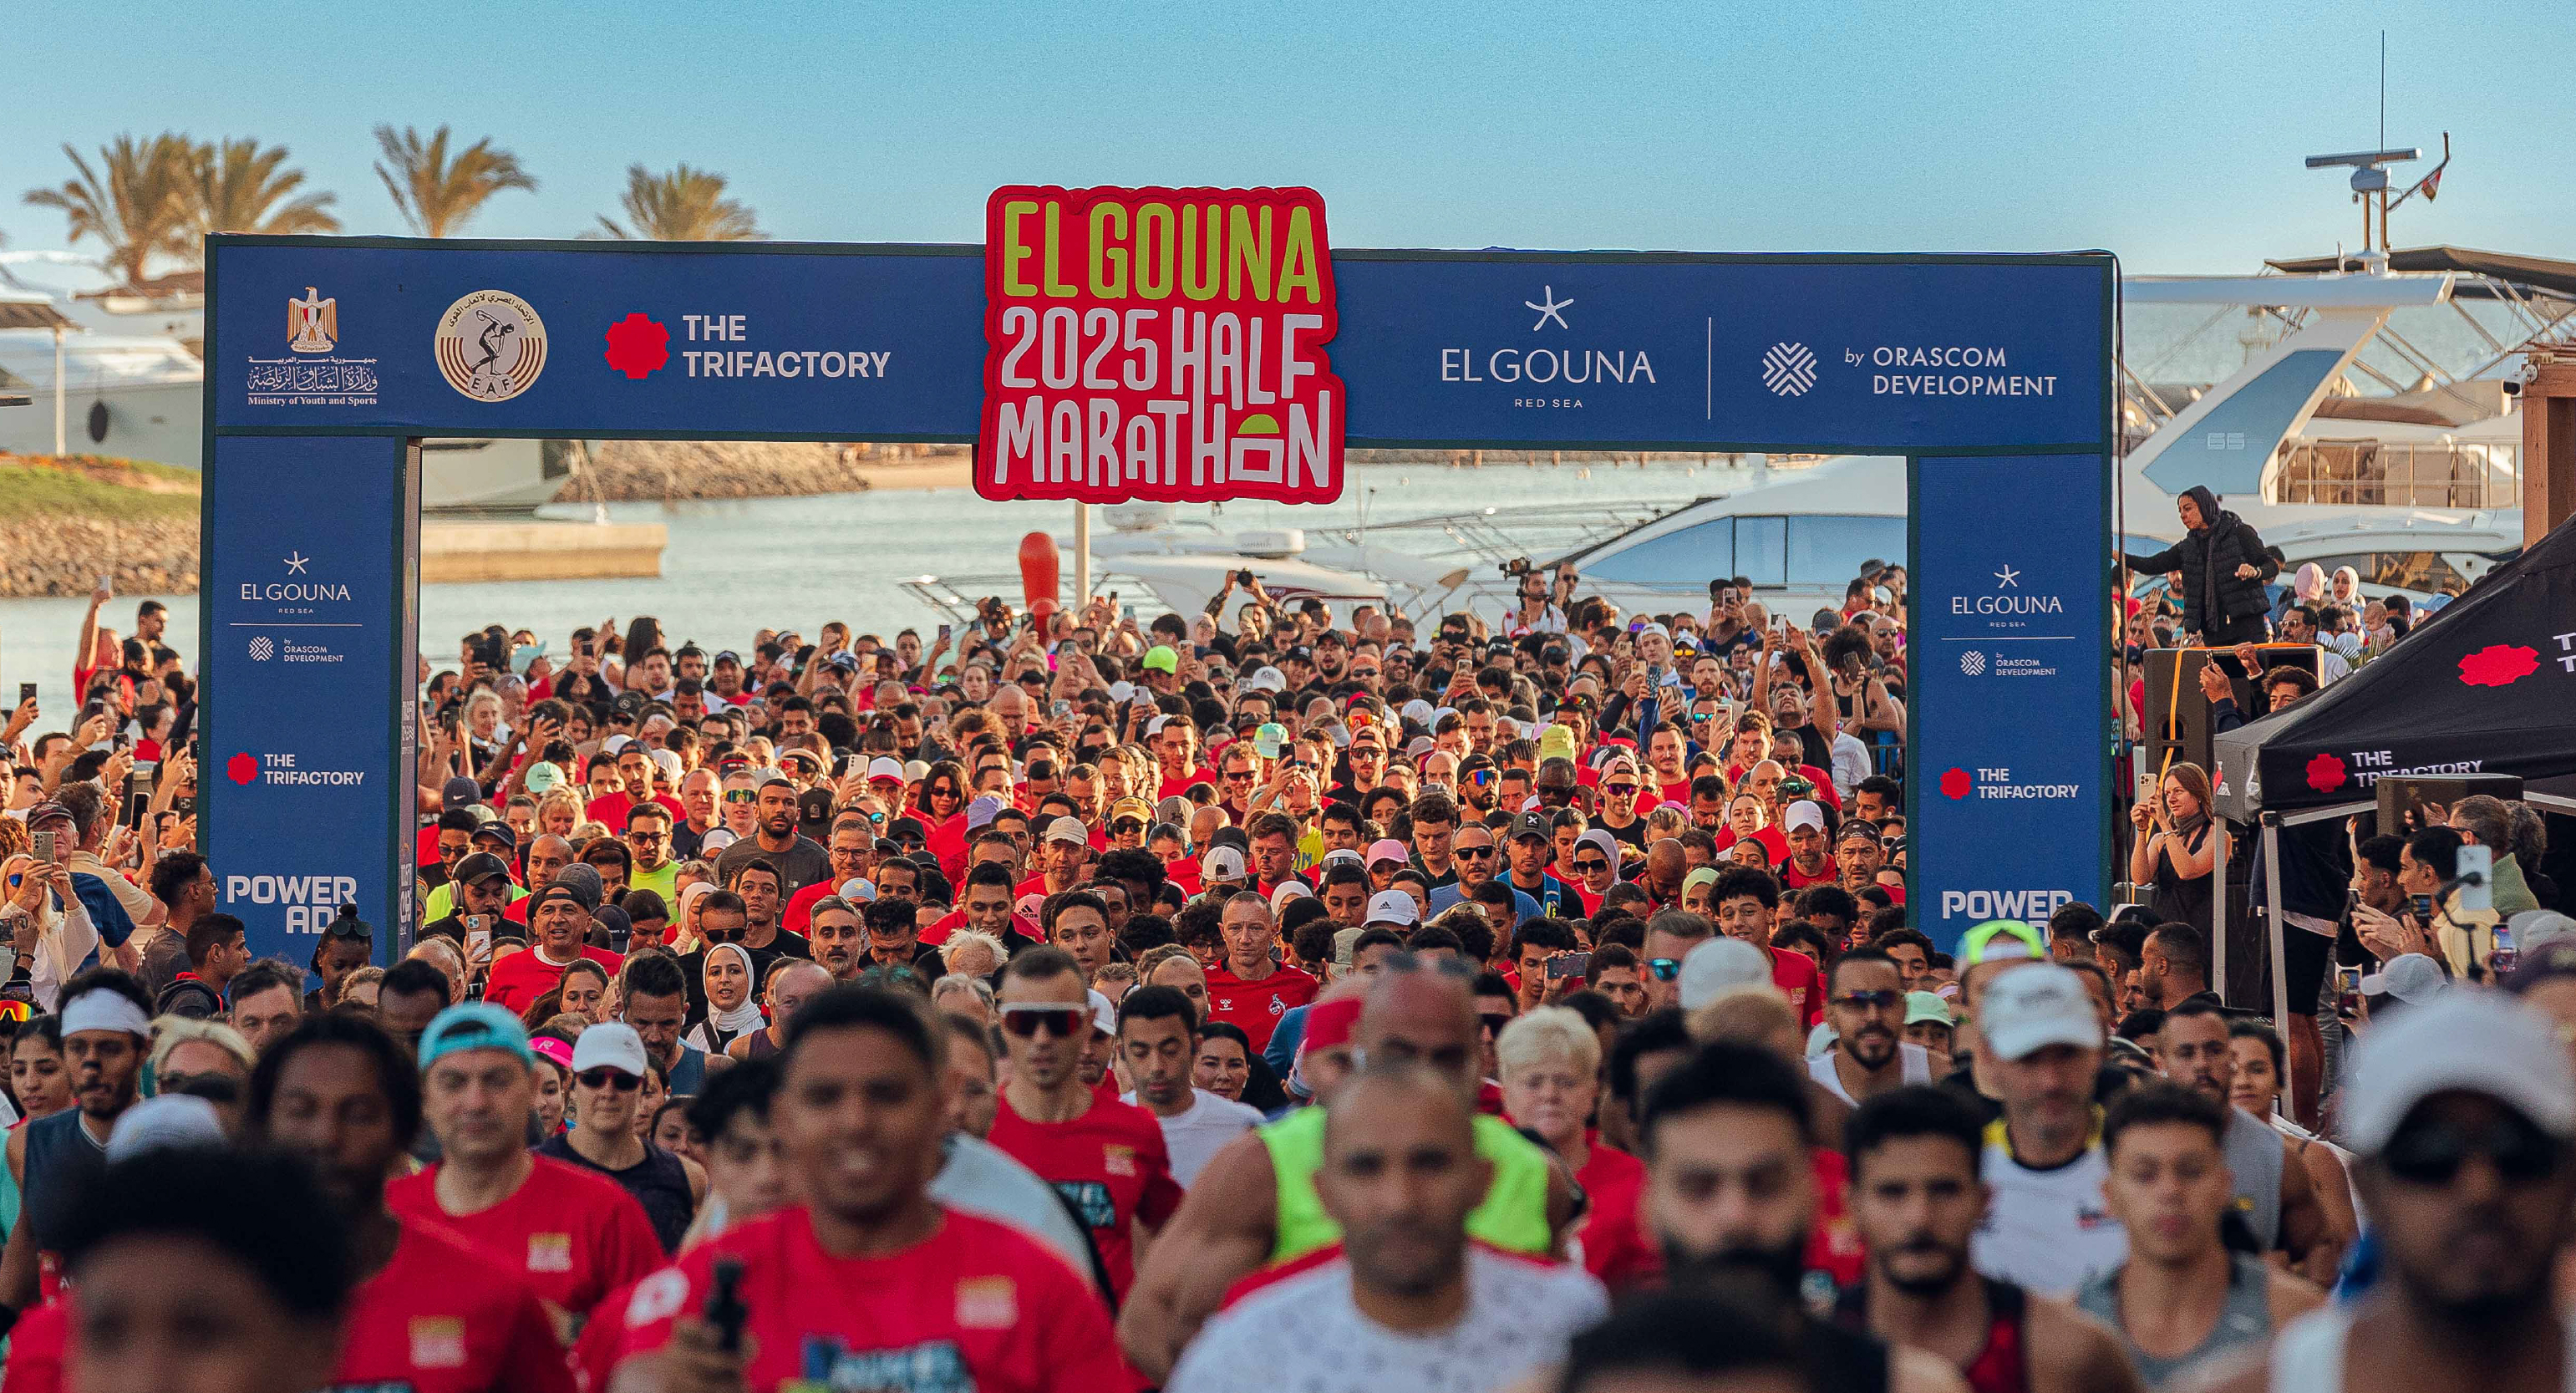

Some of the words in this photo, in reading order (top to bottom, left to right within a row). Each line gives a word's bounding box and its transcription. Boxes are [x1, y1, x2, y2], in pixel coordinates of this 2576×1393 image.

[1003, 201, 1079, 298] EL
[1089, 201, 1321, 303] GOUNA
[682, 314, 746, 341] THE
[682, 351, 892, 378] TRIFACTORY
[1002, 306, 1159, 391] 2025
[1171, 307, 1323, 410] HALF
[1441, 348, 1482, 382] EL
[1489, 348, 1656, 384] GOUNA
[1844, 348, 1865, 367] by
[1873, 347, 2007, 367] ORASCOM
[1873, 375, 2057, 396] DEVELOPMENT
[248, 396, 286, 407] Ministry
[288, 396, 298, 405] of
[300, 396, 326, 405] Youth
[328, 396, 346, 405] and
[348, 396, 377, 407] Sports
[1514, 399, 1546, 408] RED
[1552, 399, 1583, 408] SEA
[994, 390, 1330, 488] MARATHON
[241, 583, 263, 600] EL
[266, 583, 351, 601] GOUNA
[1952, 597, 1974, 614] EL
[1976, 596, 2063, 614] GOUNA
[283, 645, 328, 653] ORASCOM
[264, 754, 295, 767] THE
[2351, 750, 2393, 767] THE
[264, 771, 365, 785] TRIFACTORY
[1977, 768, 2009, 781] THE
[1977, 785, 2080, 799] TRIFACTORY
[226, 875, 358, 904] POWER
[286, 906, 342, 934] AD
